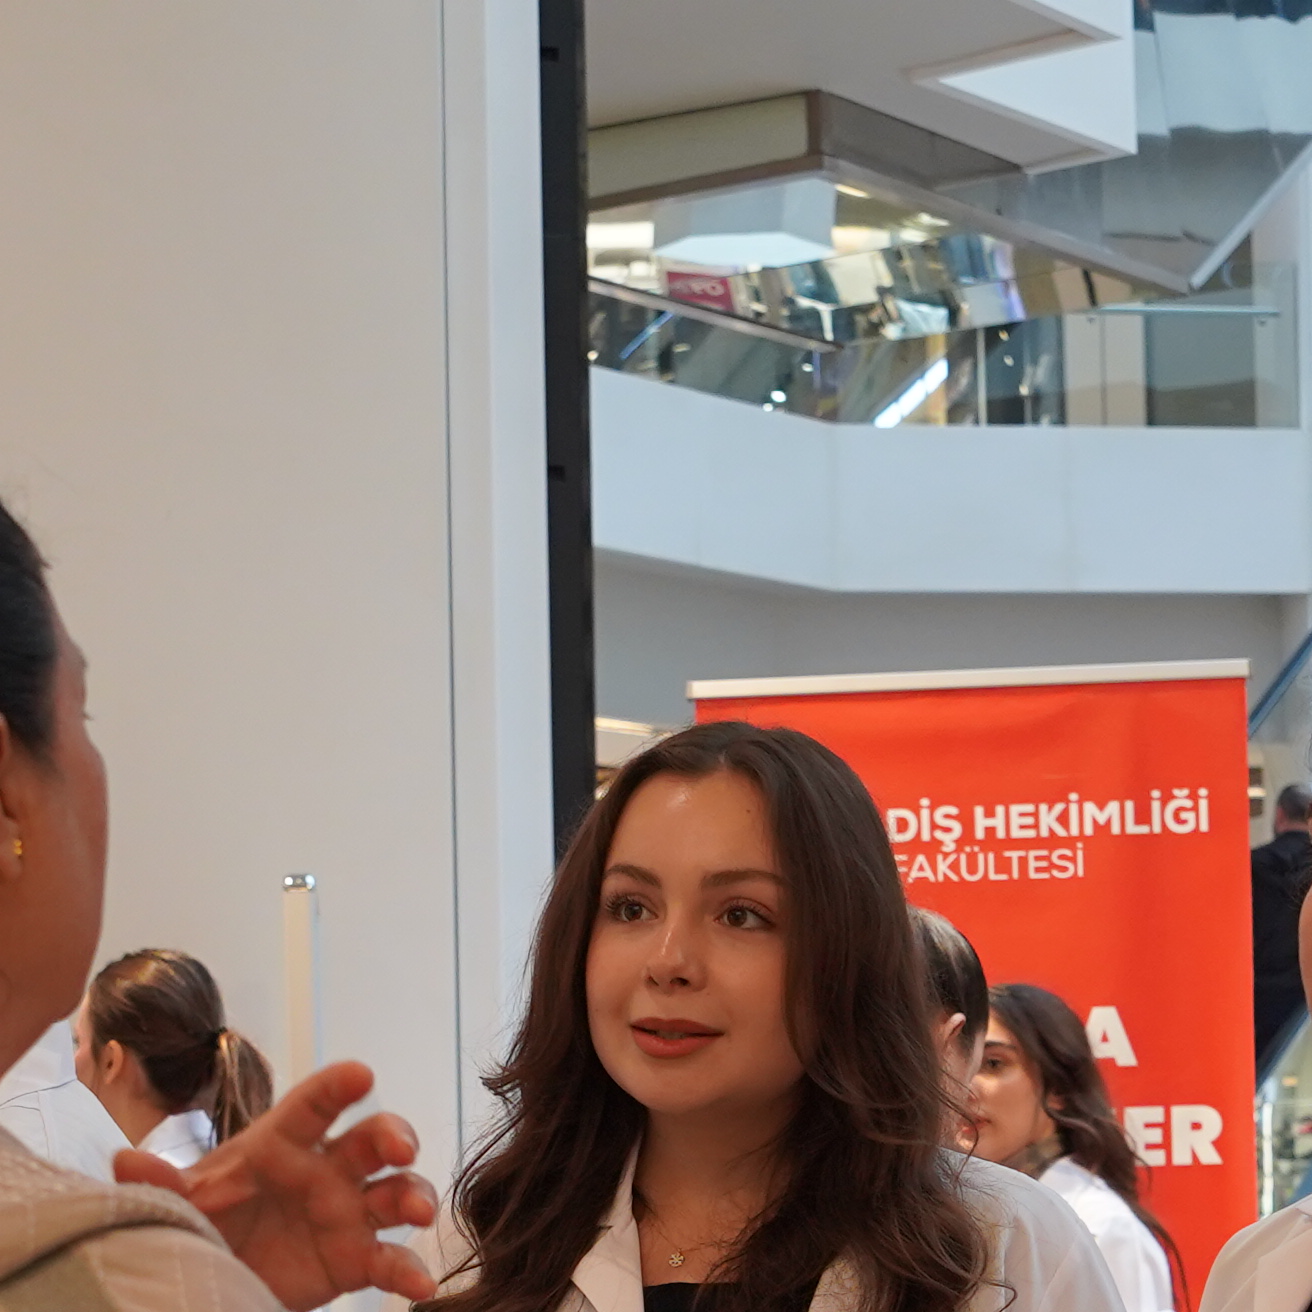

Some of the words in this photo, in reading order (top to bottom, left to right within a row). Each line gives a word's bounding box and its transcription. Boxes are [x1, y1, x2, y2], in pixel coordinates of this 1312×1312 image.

[887, 796, 963, 852] DİŞ
[974, 787, 1210, 840] HEKİMLİĞİ
[1121, 1104, 1224, 1167] ER
